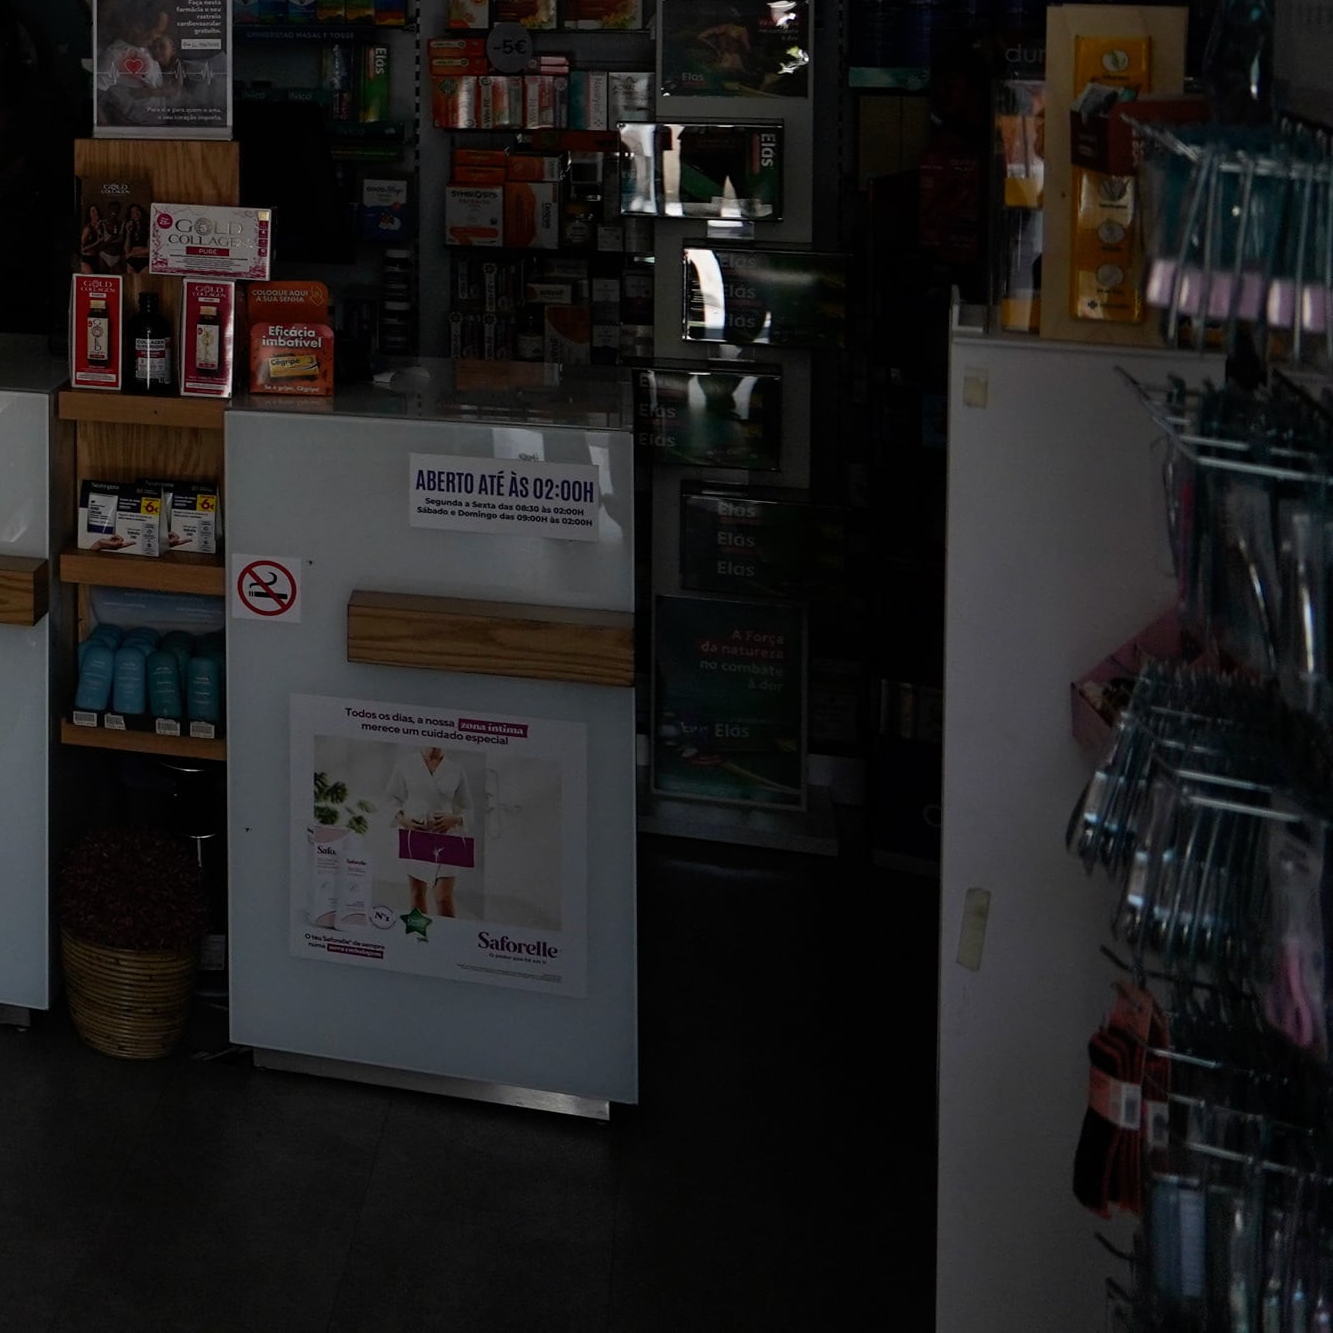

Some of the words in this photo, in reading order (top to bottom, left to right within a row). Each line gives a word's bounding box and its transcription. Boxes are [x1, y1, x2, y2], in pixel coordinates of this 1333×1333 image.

[492, 40, 527, 55] -5€
[175, 217, 244, 236] GOLD
[198, 248, 219, 256] PURE
[268, 325, 316, 338] Eficácia
[262, 335, 323, 349] imbatível
[416, 469, 474, 494] ABERTO
[478, 470, 505, 496] ATÉ
[509, 470, 529, 498] ÀS
[533, 478, 594, 503] 02:00H
[425, 497, 463, 507] Segunda
[472, 501, 496, 510] Sexta
[498, 503, 514, 511] das
[515, 504, 539, 513] 08:30
[541, 504, 551, 513] às
[553, 507, 584, 516] 02:00H
[417, 506, 449, 516] Sábado
[458, 509, 498, 520] Domingo
[500, 512, 515, 520] das
[517, 514, 548, 523] 09:00H
[550, 515, 560, 524] às
[562, 517, 593, 527] 02:00H
[344, 707, 377, 721] Todos
[378, 713, 390, 721] os
[392, 712, 416, 724] dias,
[417, 717, 424, 725] a
[425, 716, 455, 728] nossa
[460, 721, 486, 732] zona
[487, 722, 524, 736] íntima
[361, 722, 401, 735] merece
[402, 727, 419, 737] um
[421, 727, 464, 741] cuidado
[465, 733, 509, 746] especial
[478, 930, 559, 959] Saforelle
